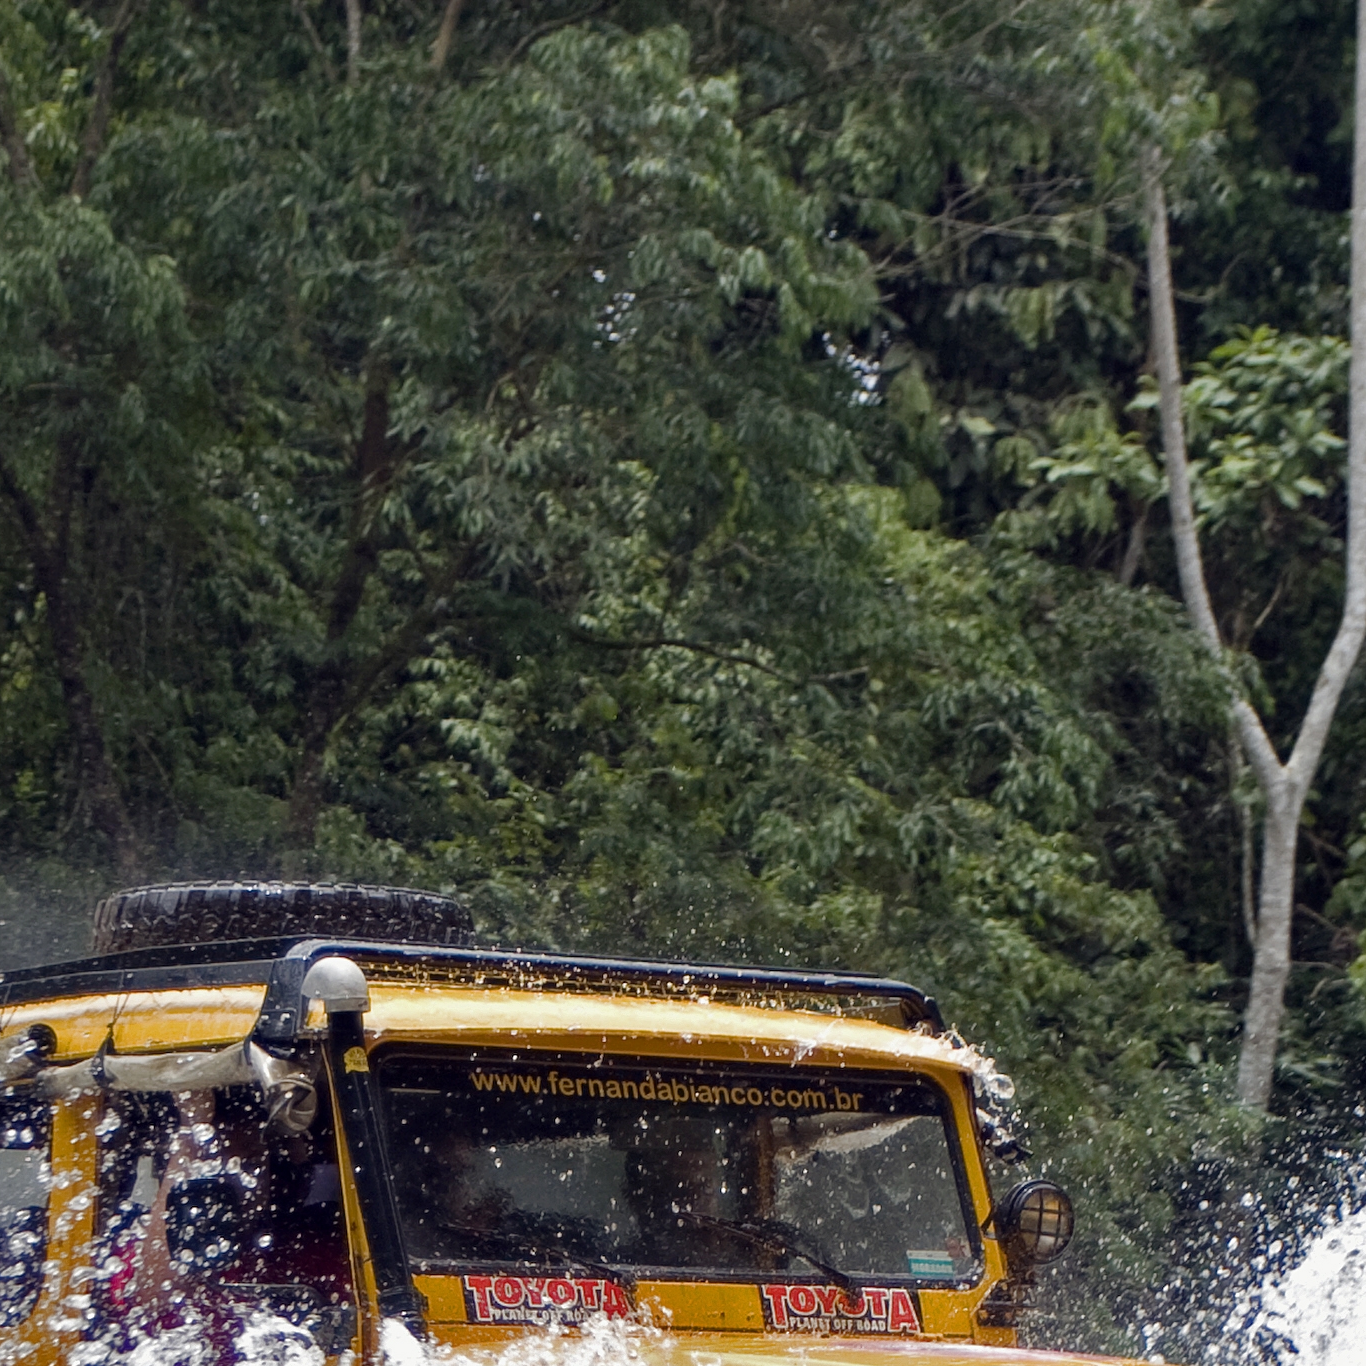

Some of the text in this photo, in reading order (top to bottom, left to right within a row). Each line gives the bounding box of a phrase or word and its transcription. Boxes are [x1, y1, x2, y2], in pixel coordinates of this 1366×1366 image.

[470, 1070, 864, 1111] www.fernandabianco.com.br
[464, 1275, 631, 1322] TOYOTA
[762, 1284, 921, 1333] TOYOTA
[789, 1317, 887, 1332] PLANET OFF ROAD
